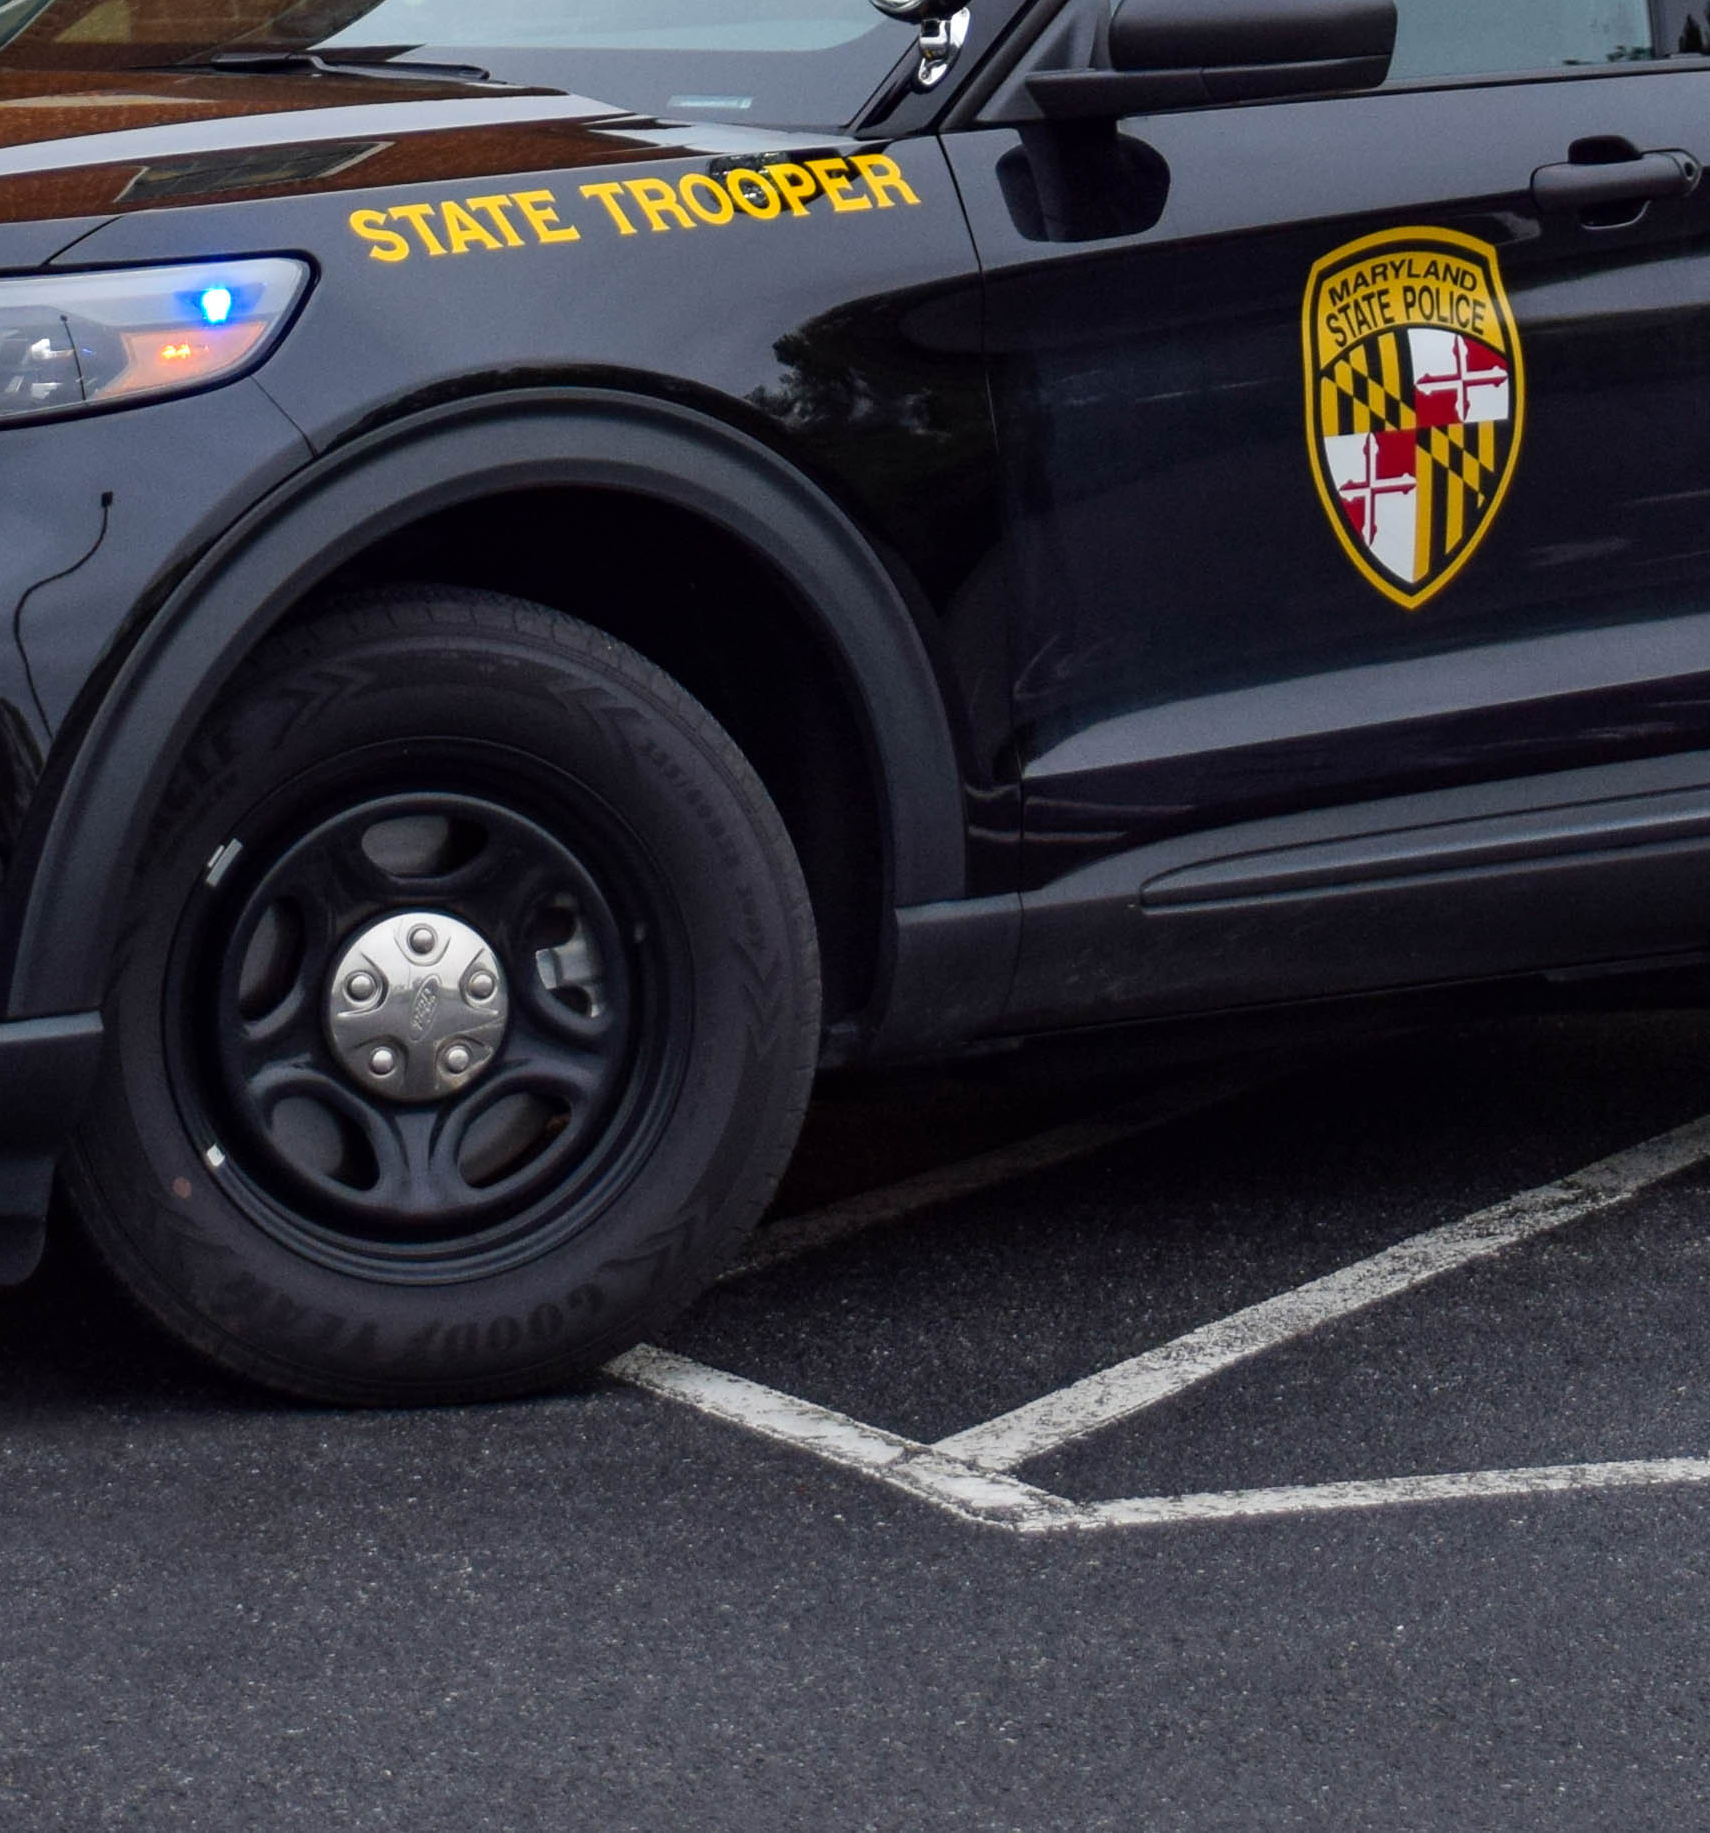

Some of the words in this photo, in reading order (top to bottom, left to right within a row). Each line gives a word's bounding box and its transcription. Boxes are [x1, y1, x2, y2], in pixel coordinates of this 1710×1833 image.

[349, 189, 581, 263] STATE
[580, 153, 921, 236] TROOPER
[1328, 259, 1478, 307] MARYLAND
[1325, 288, 1395, 348] STATE
[1402, 285, 1486, 336] POLICE
